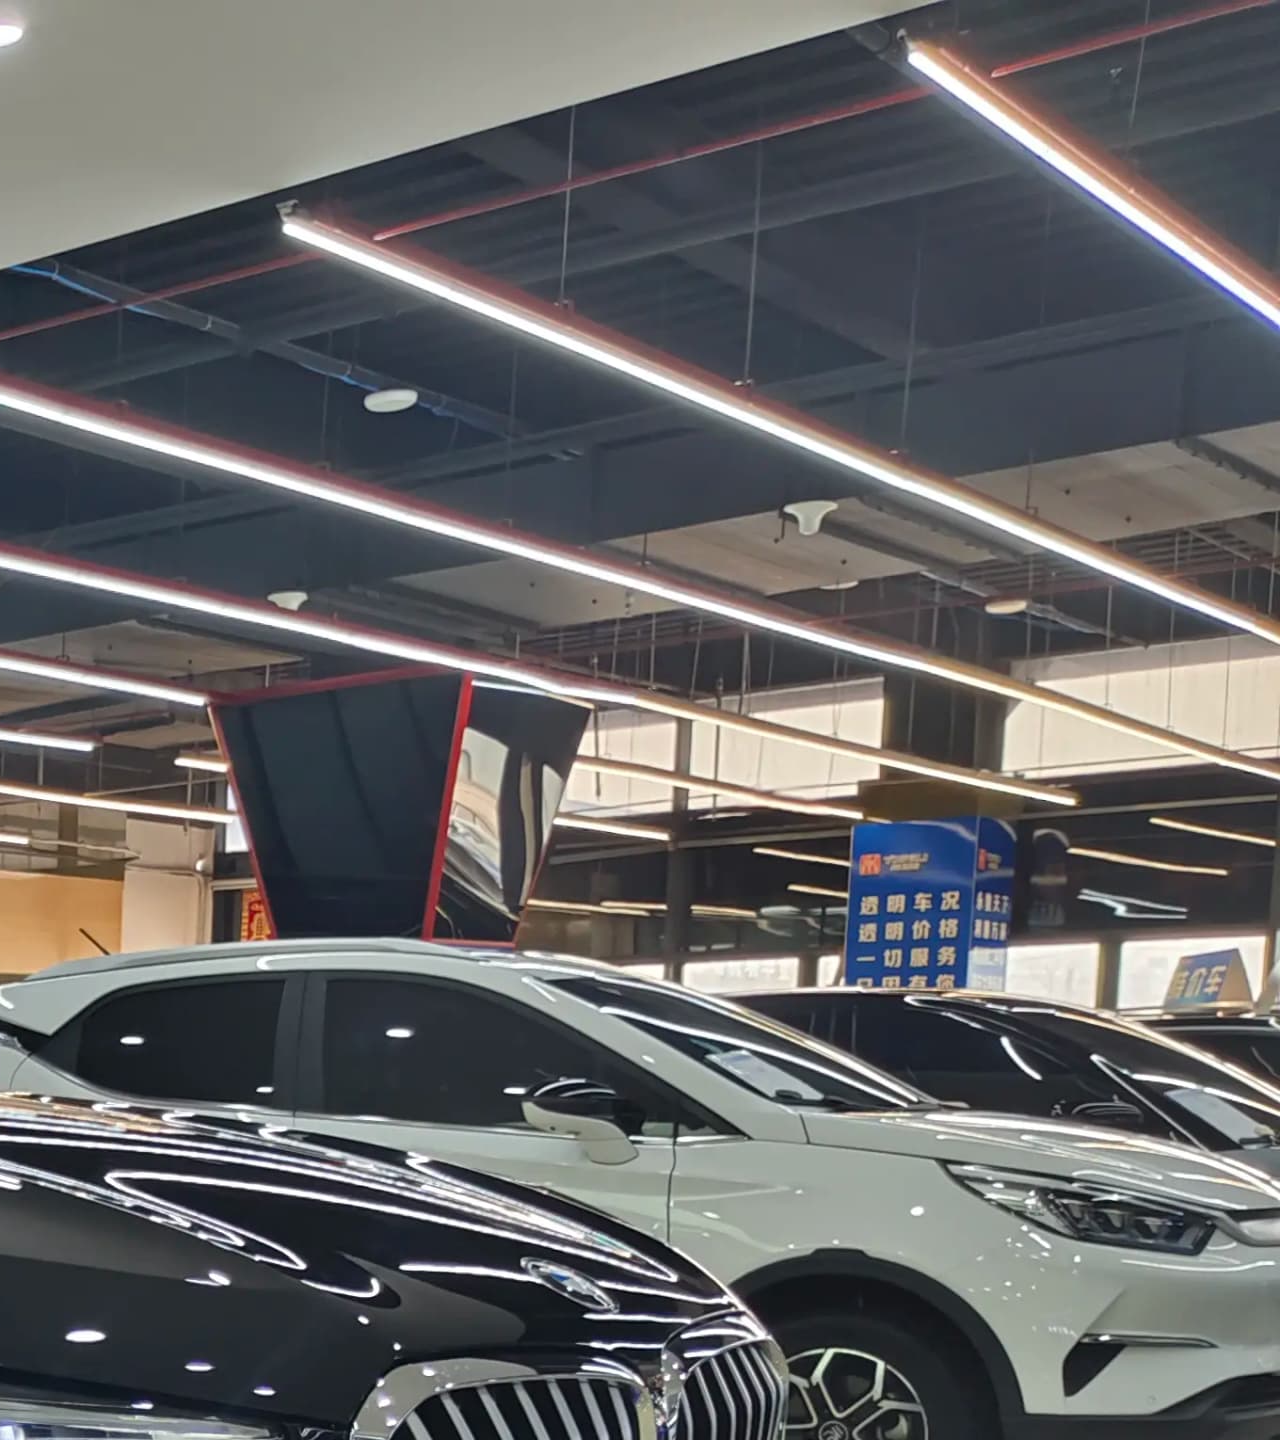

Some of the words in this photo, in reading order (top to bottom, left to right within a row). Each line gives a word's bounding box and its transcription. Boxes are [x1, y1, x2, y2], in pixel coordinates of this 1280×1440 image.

[859, 890, 961, 916] 透明车况
[857, 918, 960, 943] 透明价格
[856, 946, 957, 968] 一切服务
